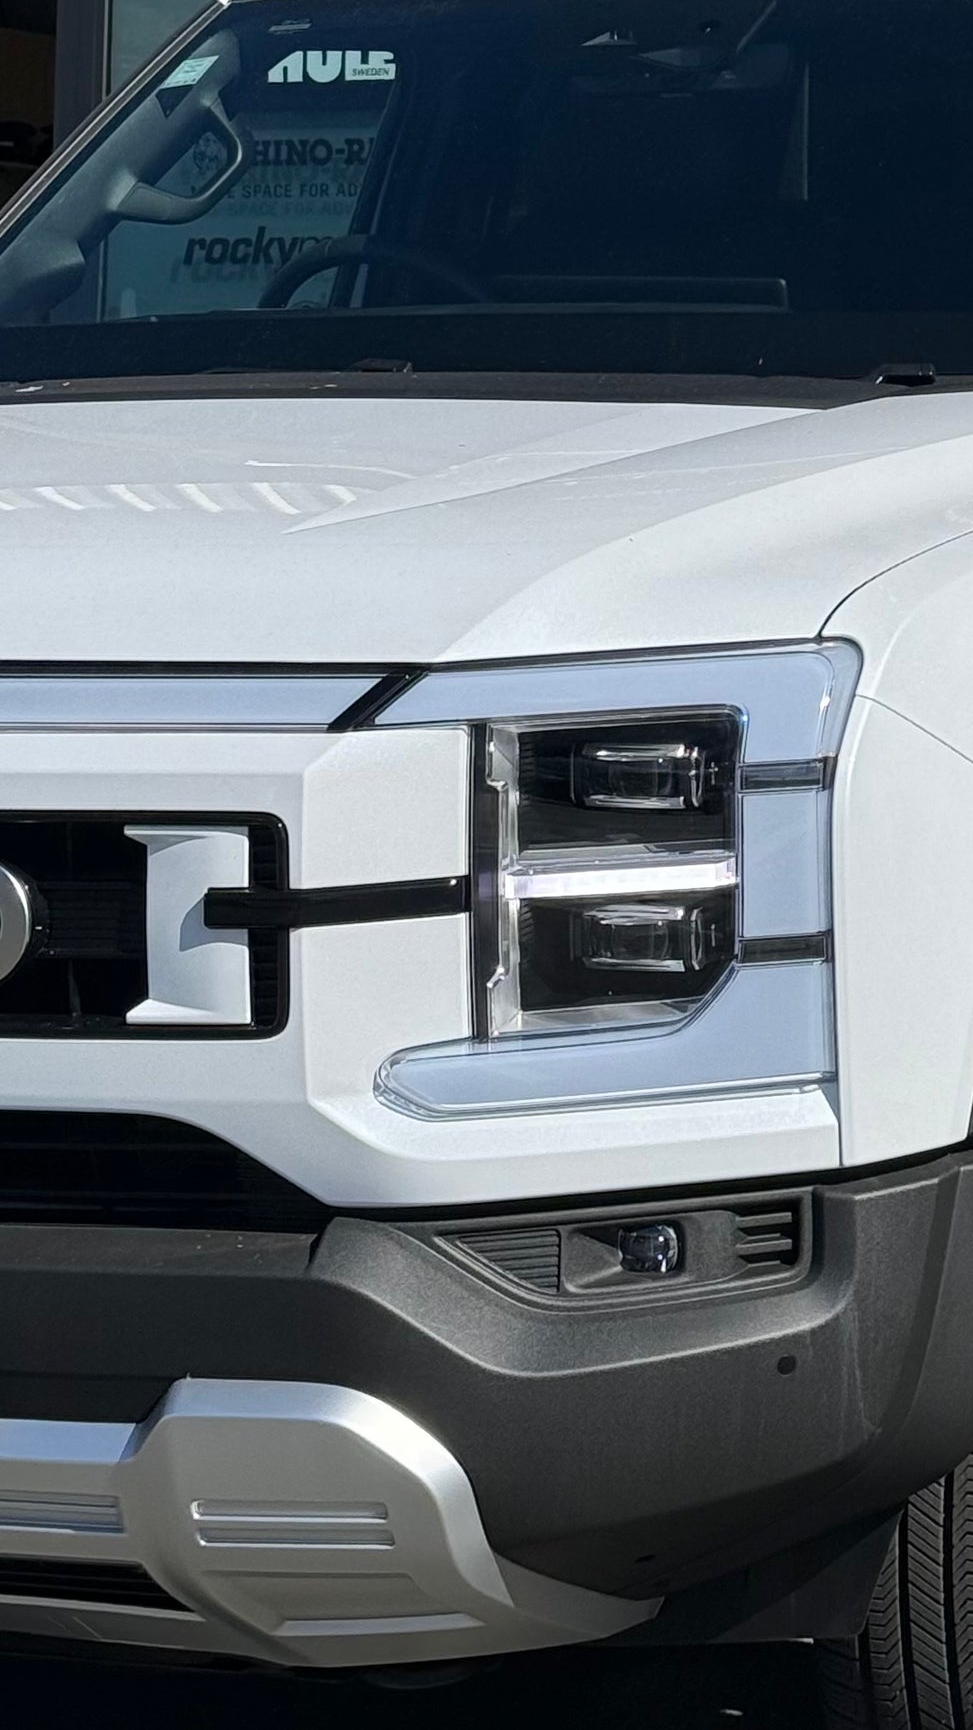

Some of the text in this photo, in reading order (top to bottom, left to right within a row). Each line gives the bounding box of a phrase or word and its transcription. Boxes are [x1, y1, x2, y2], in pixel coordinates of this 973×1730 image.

[352, 67, 390, 77] SWEDEN
[242, 184, 292, 199] SPACE
[300, 184, 329, 198] FOR
